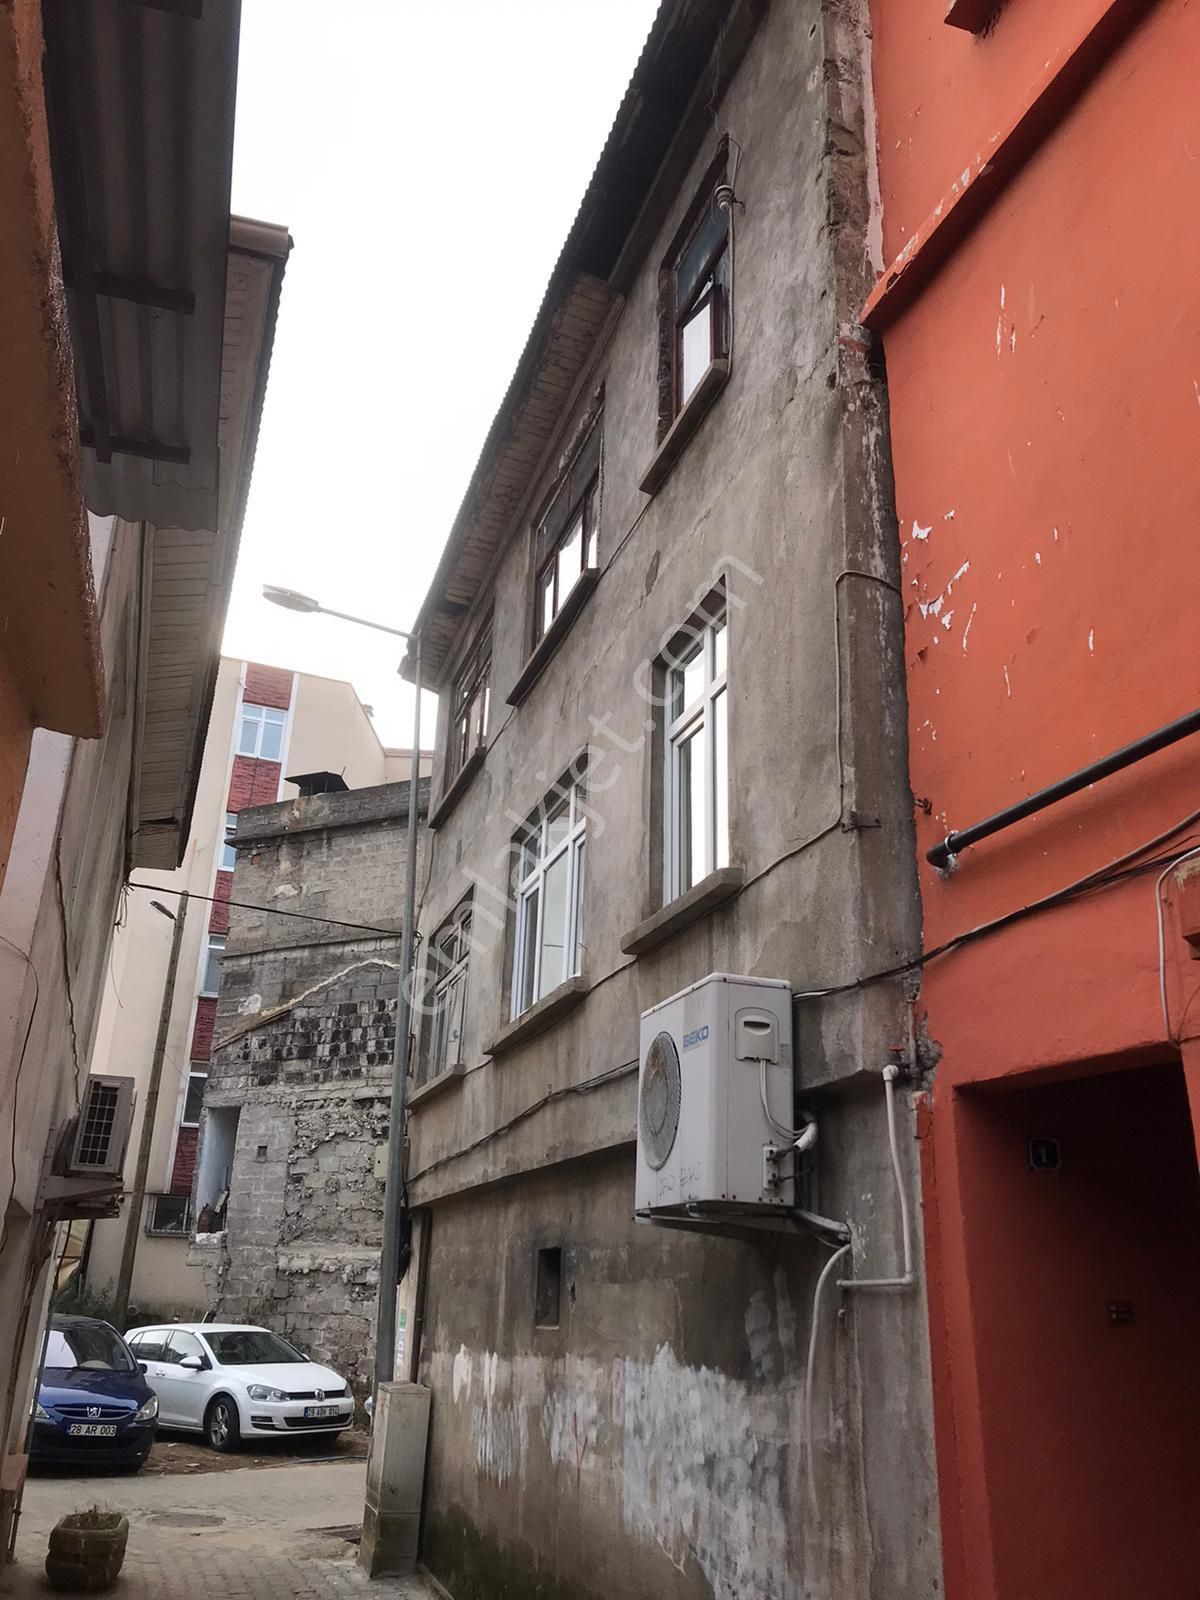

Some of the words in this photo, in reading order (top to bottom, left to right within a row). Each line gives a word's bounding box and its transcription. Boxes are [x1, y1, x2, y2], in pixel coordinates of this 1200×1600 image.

[683, 1025, 709, 1048] BEKO
[71, 1424, 81, 1434] 28
[85, 1426, 97, 1434] AR
[100, 1427, 115, 1435] 003
